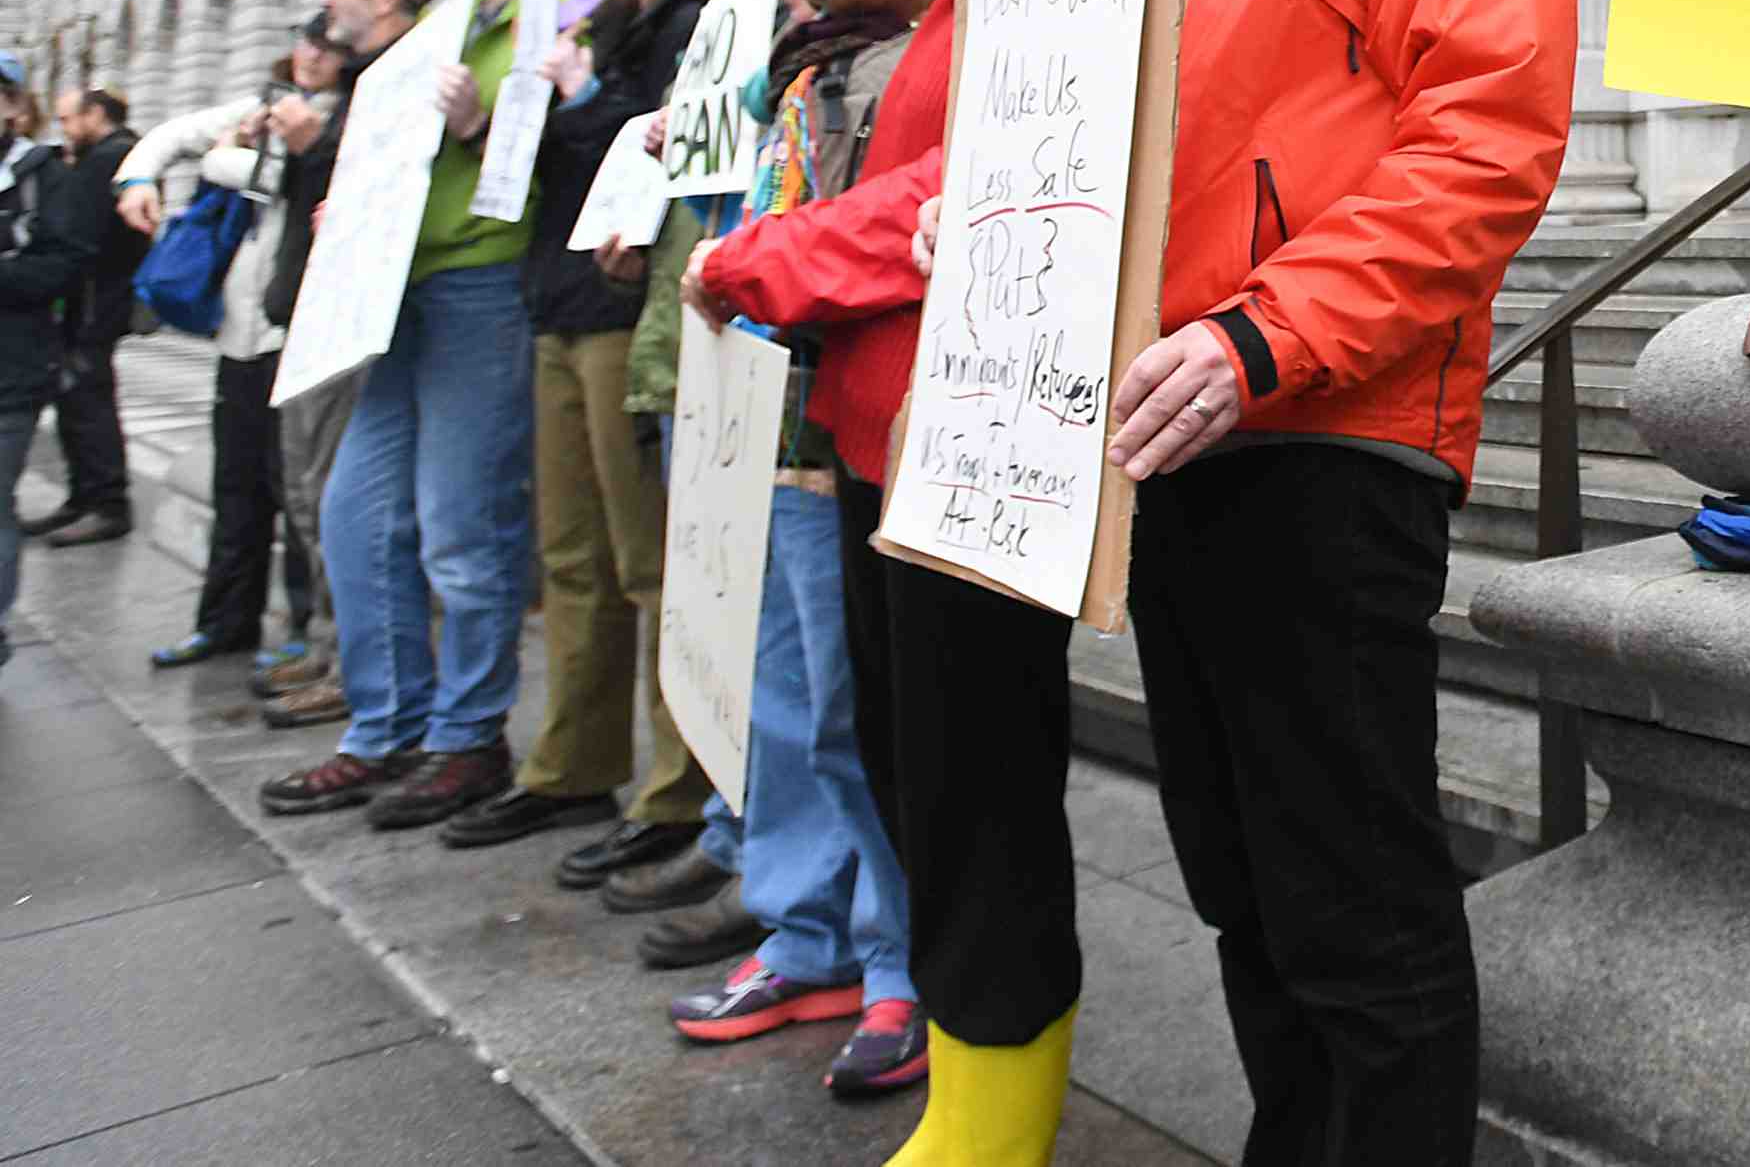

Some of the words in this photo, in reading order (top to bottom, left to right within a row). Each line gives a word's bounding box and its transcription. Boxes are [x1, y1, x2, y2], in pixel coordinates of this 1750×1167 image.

[667, 86, 744, 181] BAN
[967, 149, 1013, 211] Less
[1031, 119, 1098, 198] Safe
